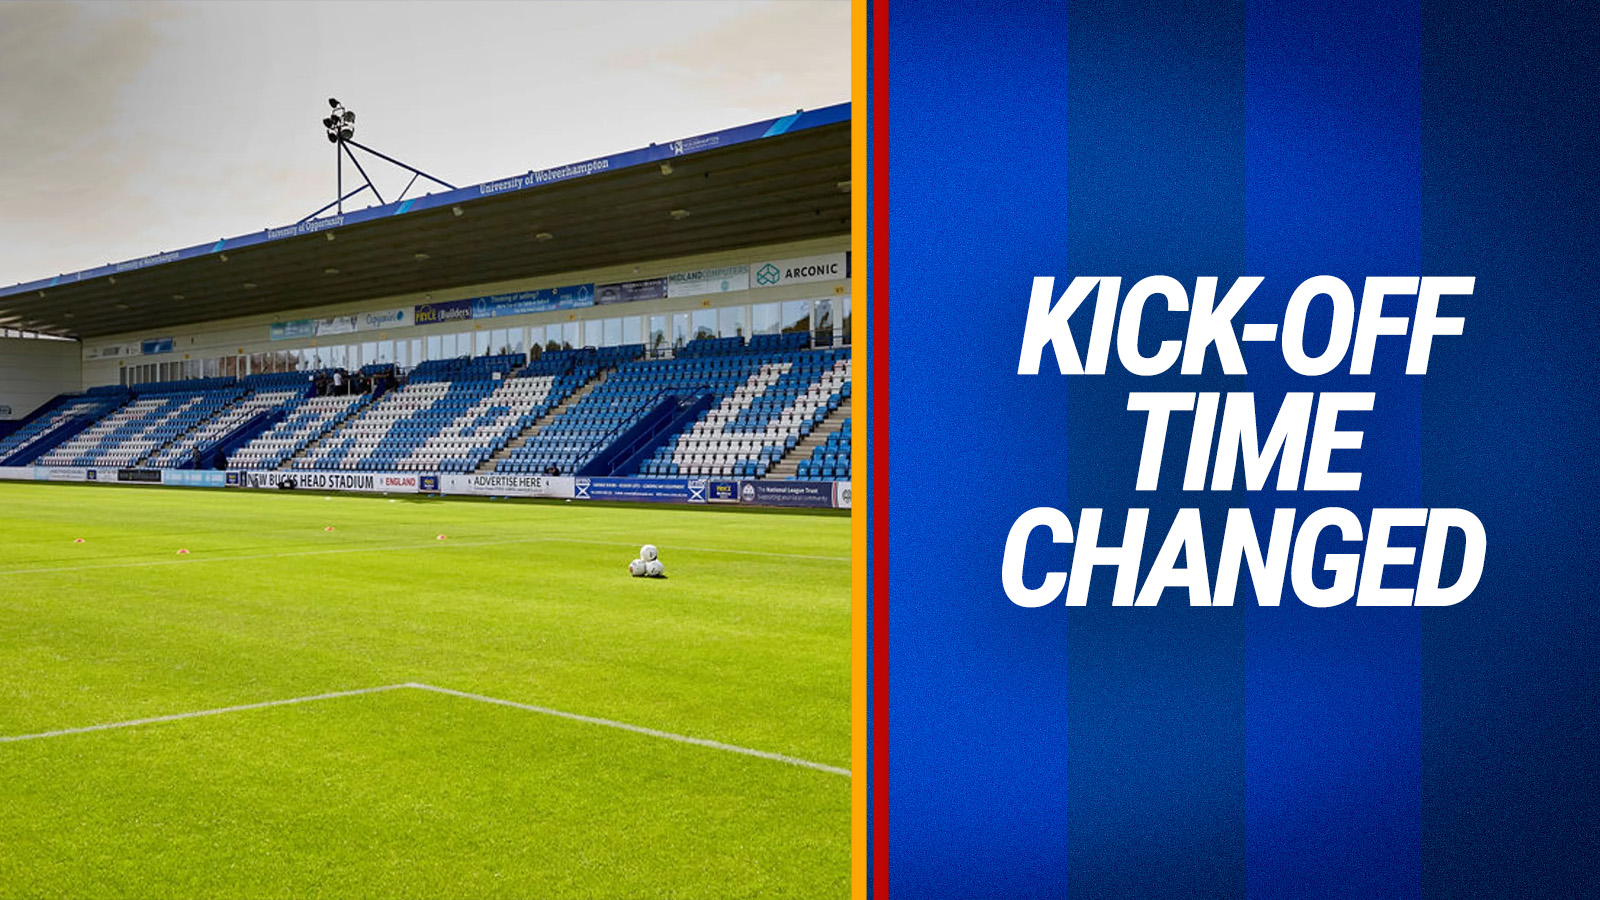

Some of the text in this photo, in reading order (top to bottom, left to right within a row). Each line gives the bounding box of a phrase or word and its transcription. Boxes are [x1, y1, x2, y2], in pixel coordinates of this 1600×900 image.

[480, 159, 609, 194] University of Wolverhampton
[785, 263, 838, 279] ARCONIC
[247, 473, 268, 486] NEW
[270, 474, 298, 487] BUCKS
[300, 474, 326, 488] HEAD
[329, 475, 374, 489] STADIUM
[385, 478, 416, 487] ENGLAND
[474, 476, 541, 487] ADVERTISE HERE
